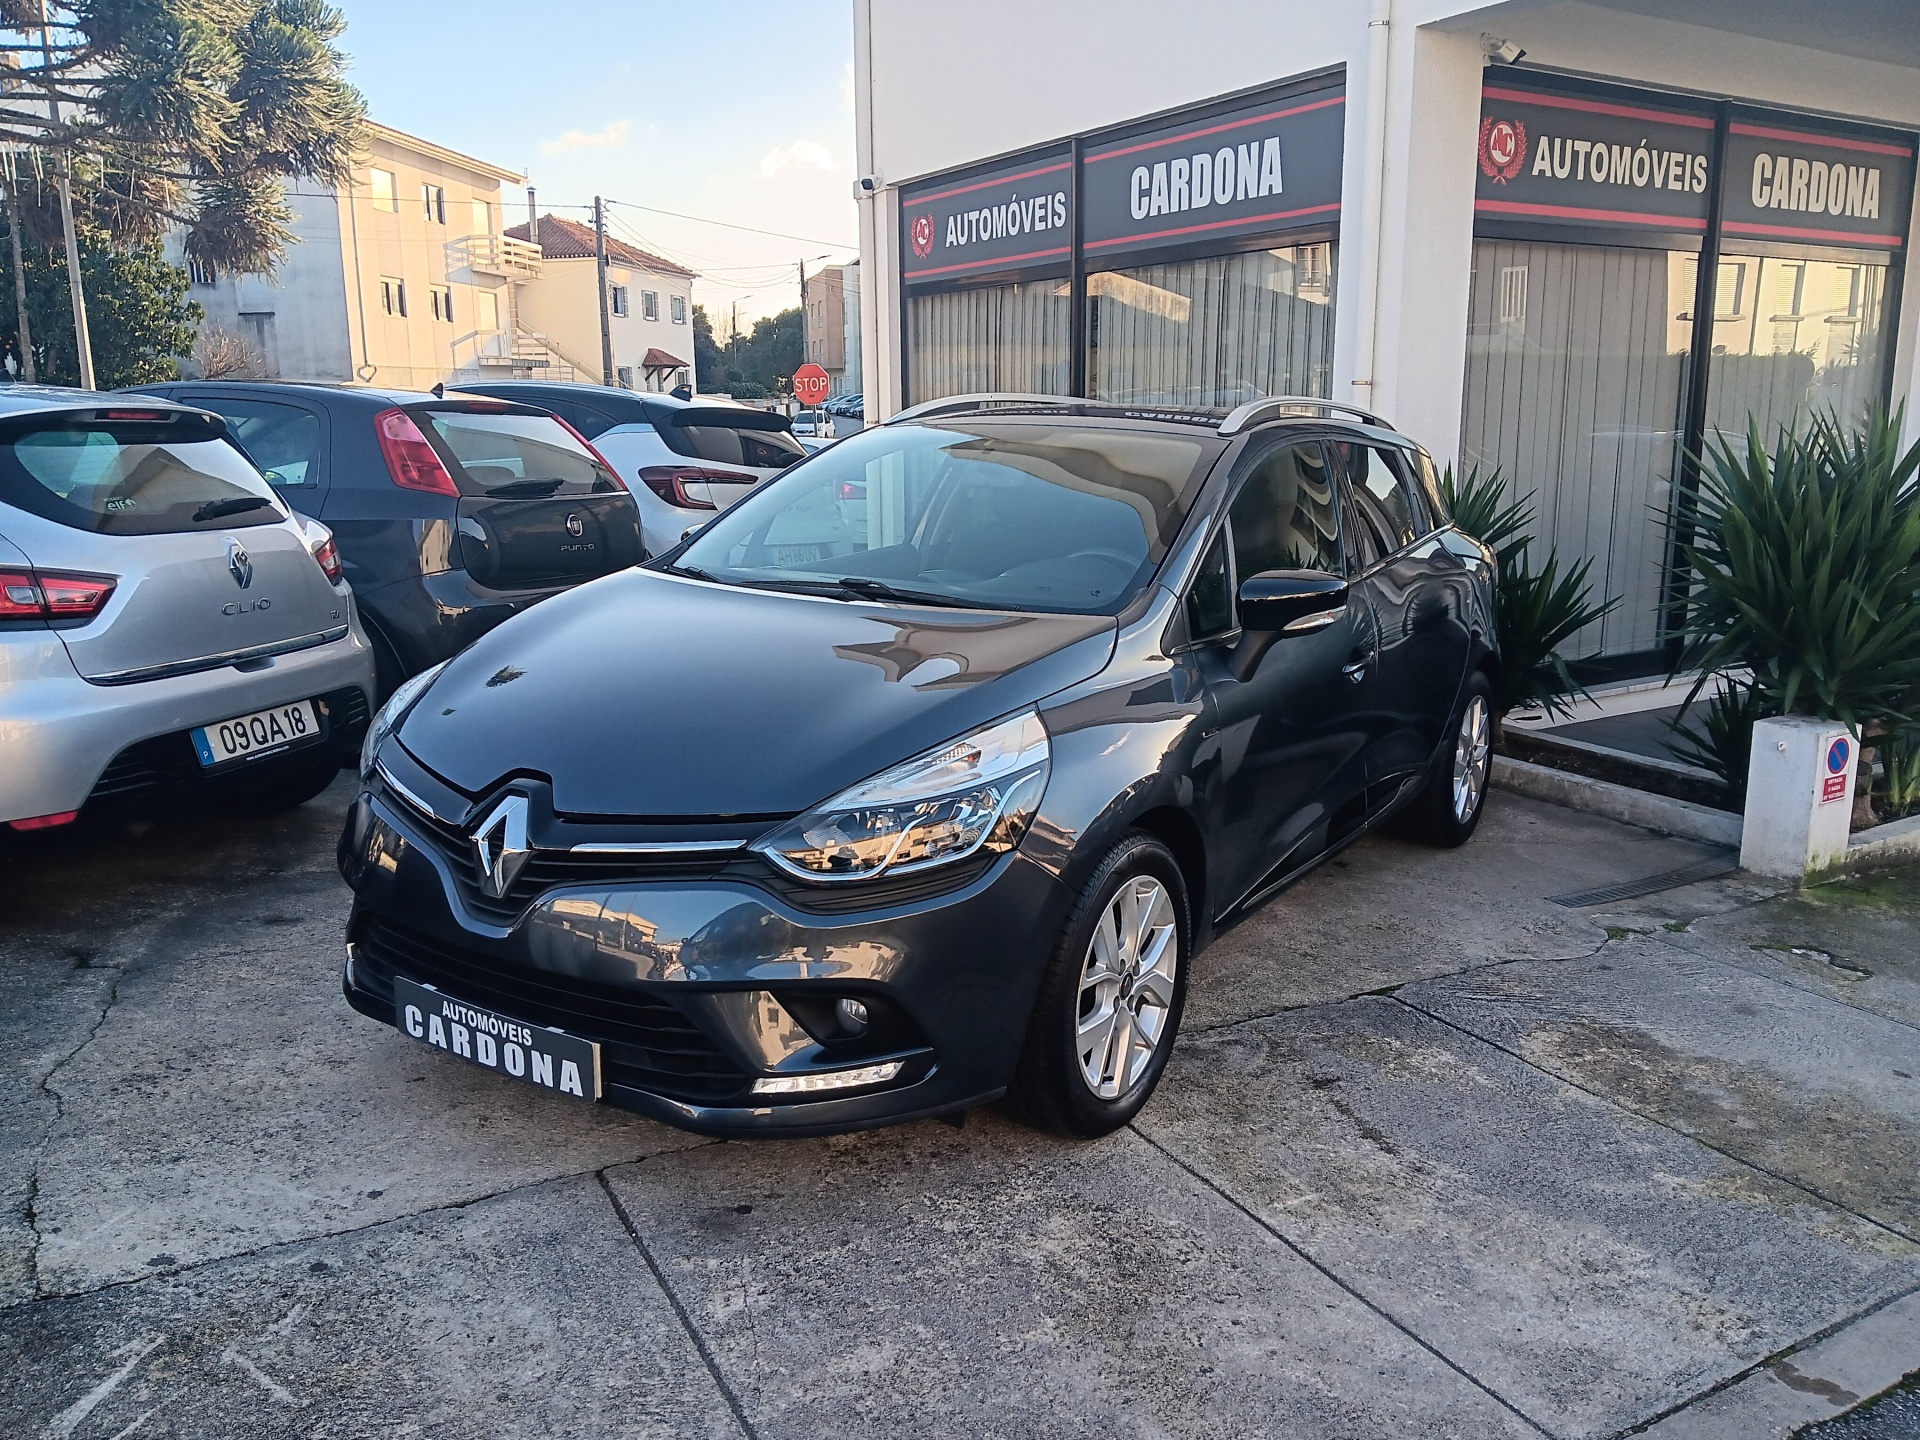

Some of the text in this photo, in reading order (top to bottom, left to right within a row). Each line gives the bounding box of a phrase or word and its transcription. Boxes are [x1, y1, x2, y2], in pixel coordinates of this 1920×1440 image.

[1531, 135, 1880, 219] AUTOMÓVEIS CARDONA
[945, 136, 1283, 248] AUTOMÓVEIS CARDONA
[795, 377, 828, 392] STOP
[107, 500, 126, 510] elf
[560, 543, 595, 552] PUNTO
[221, 597, 271, 616] CLIO
[202, 750, 209, 759] P
[442, 1000, 533, 1046] AUTOMÓVEIS
[404, 1004, 584, 1097] CARDONA
